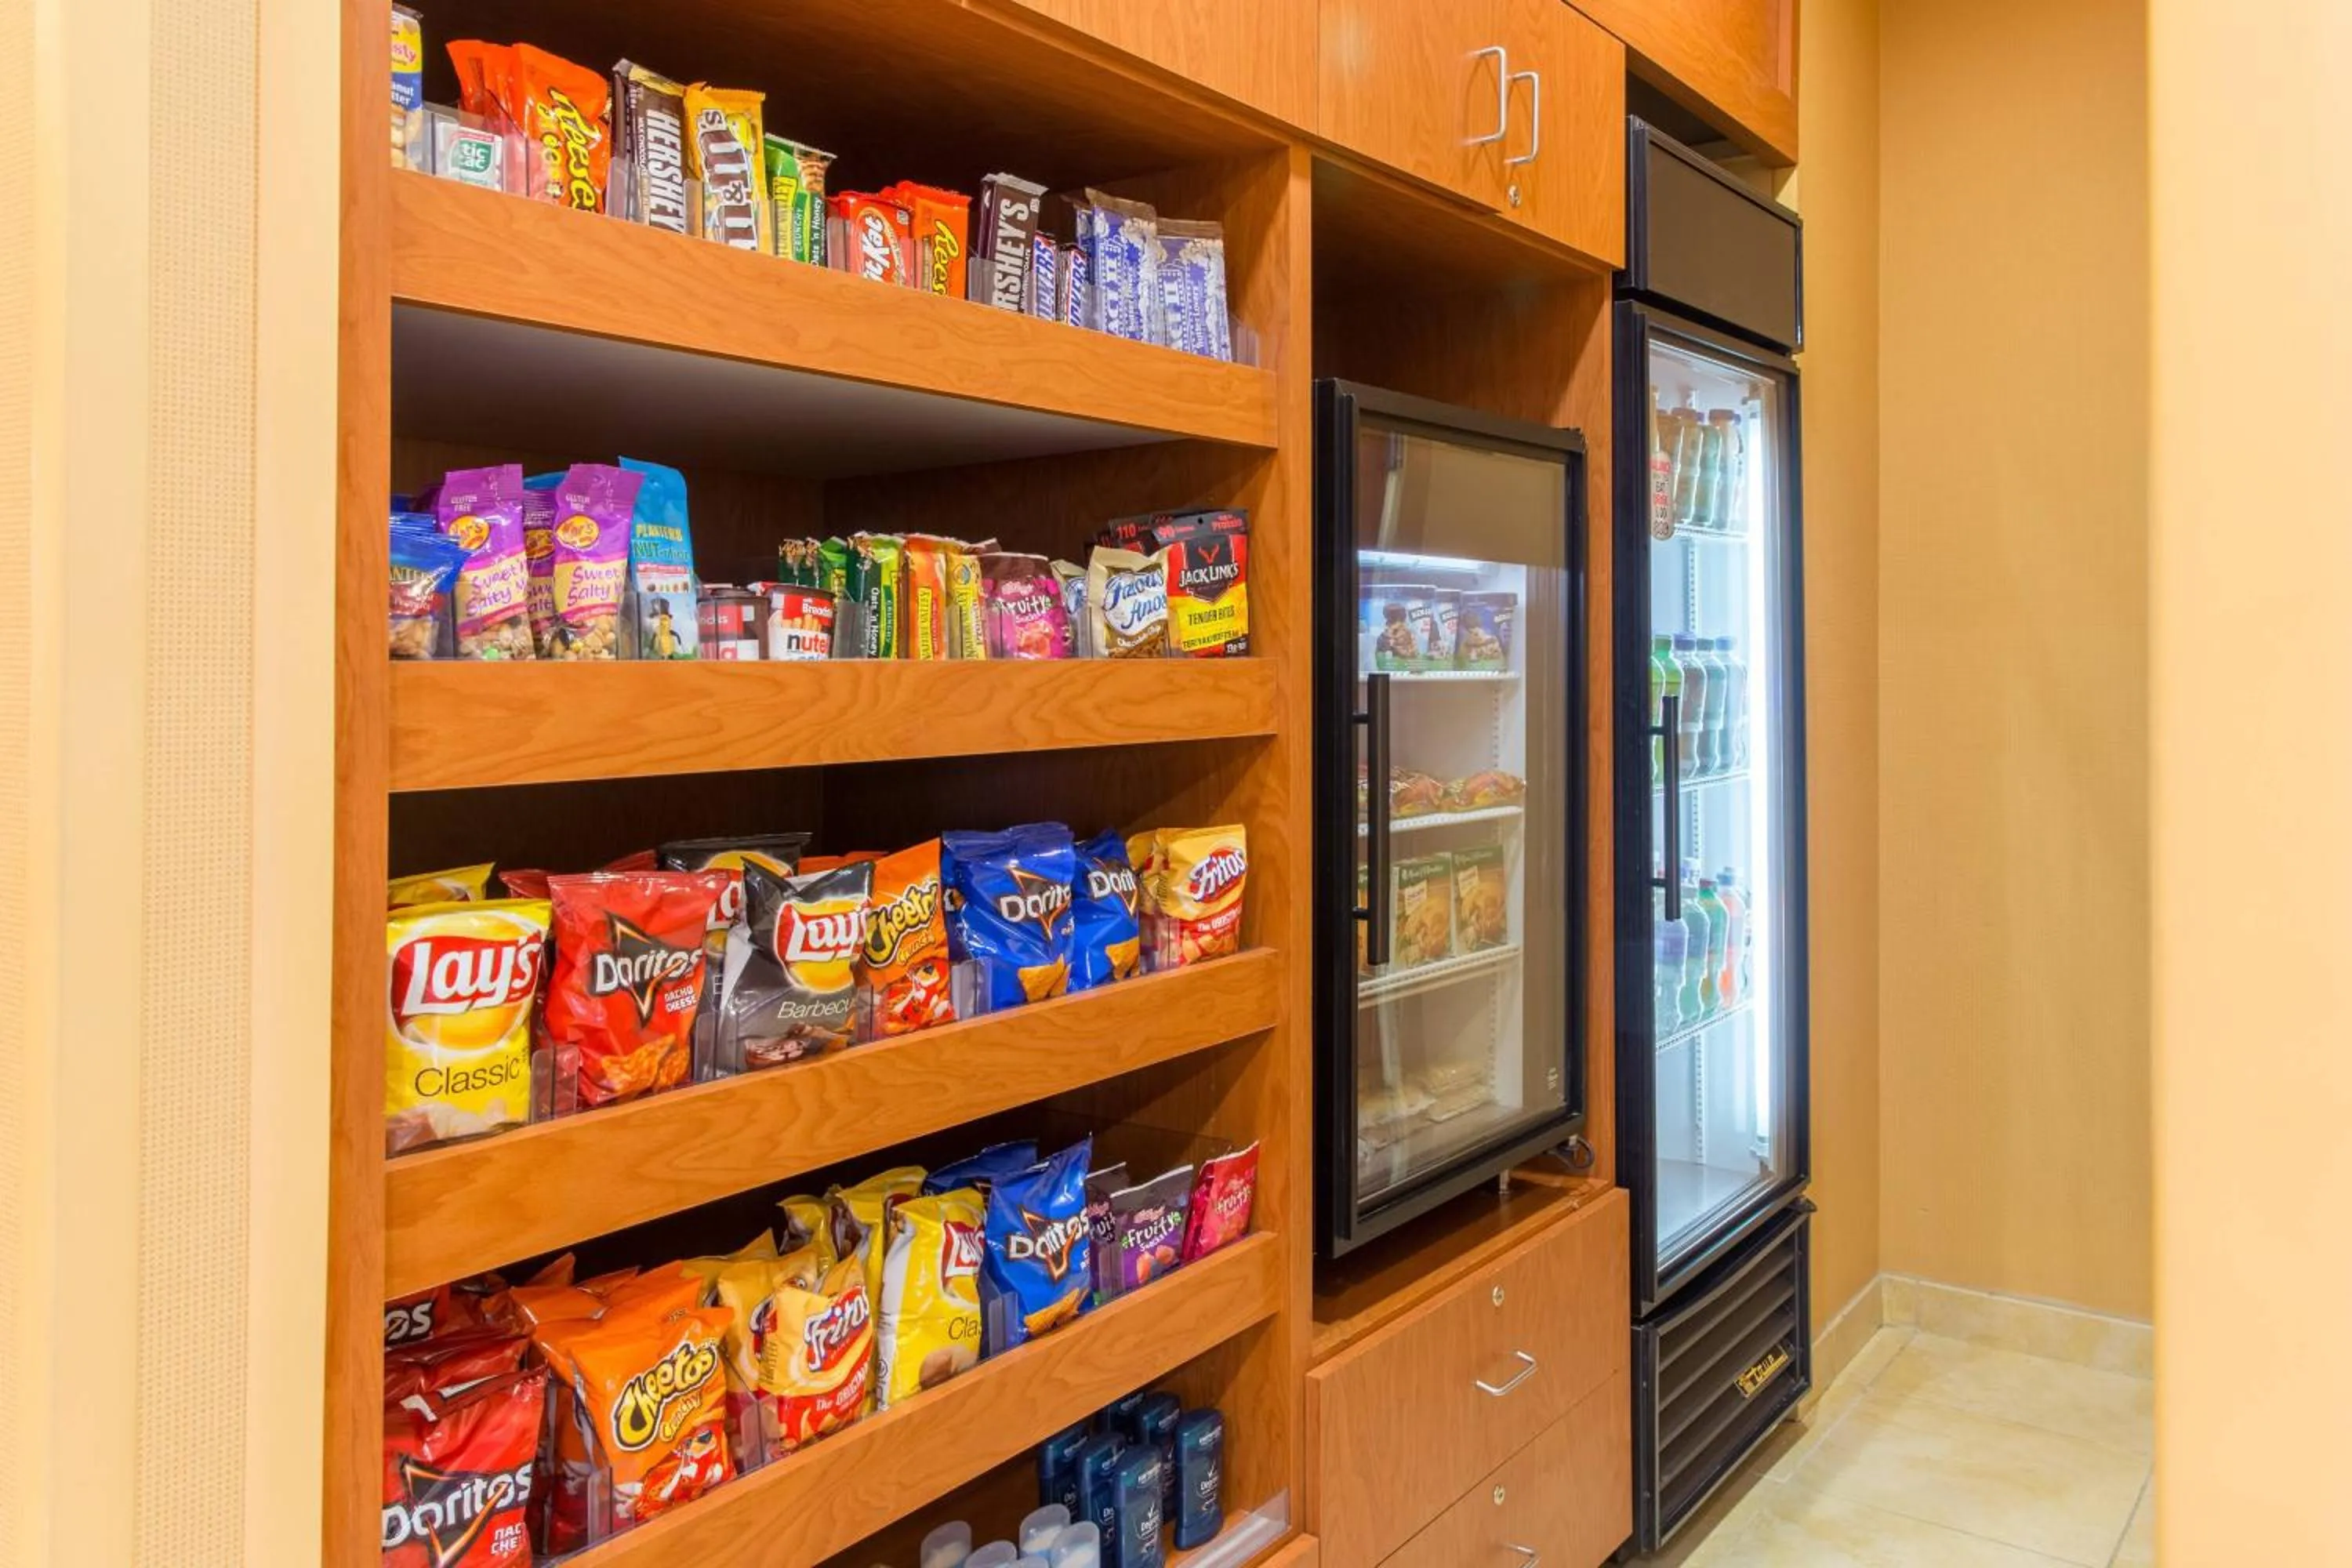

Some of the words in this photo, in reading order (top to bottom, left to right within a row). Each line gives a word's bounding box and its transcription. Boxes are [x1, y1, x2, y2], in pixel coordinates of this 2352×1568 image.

[549, 88, 602, 210] Reese
[646, 109, 685, 234] HERSHEY
[932, 220, 959, 295] Rees
[993, 198, 1029, 310] RSHEY'S
[567, 583, 610, 607] Salty
[870, 587, 880, 609] Oats
[1179, 568, 1210, 587] JACK
[787, 633, 828, 653] nute
[869, 625, 879, 655] Honey
[1190, 850, 1245, 901] Fritos
[401, 936, 541, 1015] Lay's
[596, 948, 703, 993] Doritos
[778, 998, 850, 1018] Barbec
[415, 1055, 520, 1097] Classic
[1010, 1209, 1089, 1258] Doritos
[1127, 1213, 1174, 1247] Fruity
[619, 1345, 716, 1447] Cheetos
[382, 1465, 532, 1548] Doritos
[494, 1523, 522, 1541] NAC
